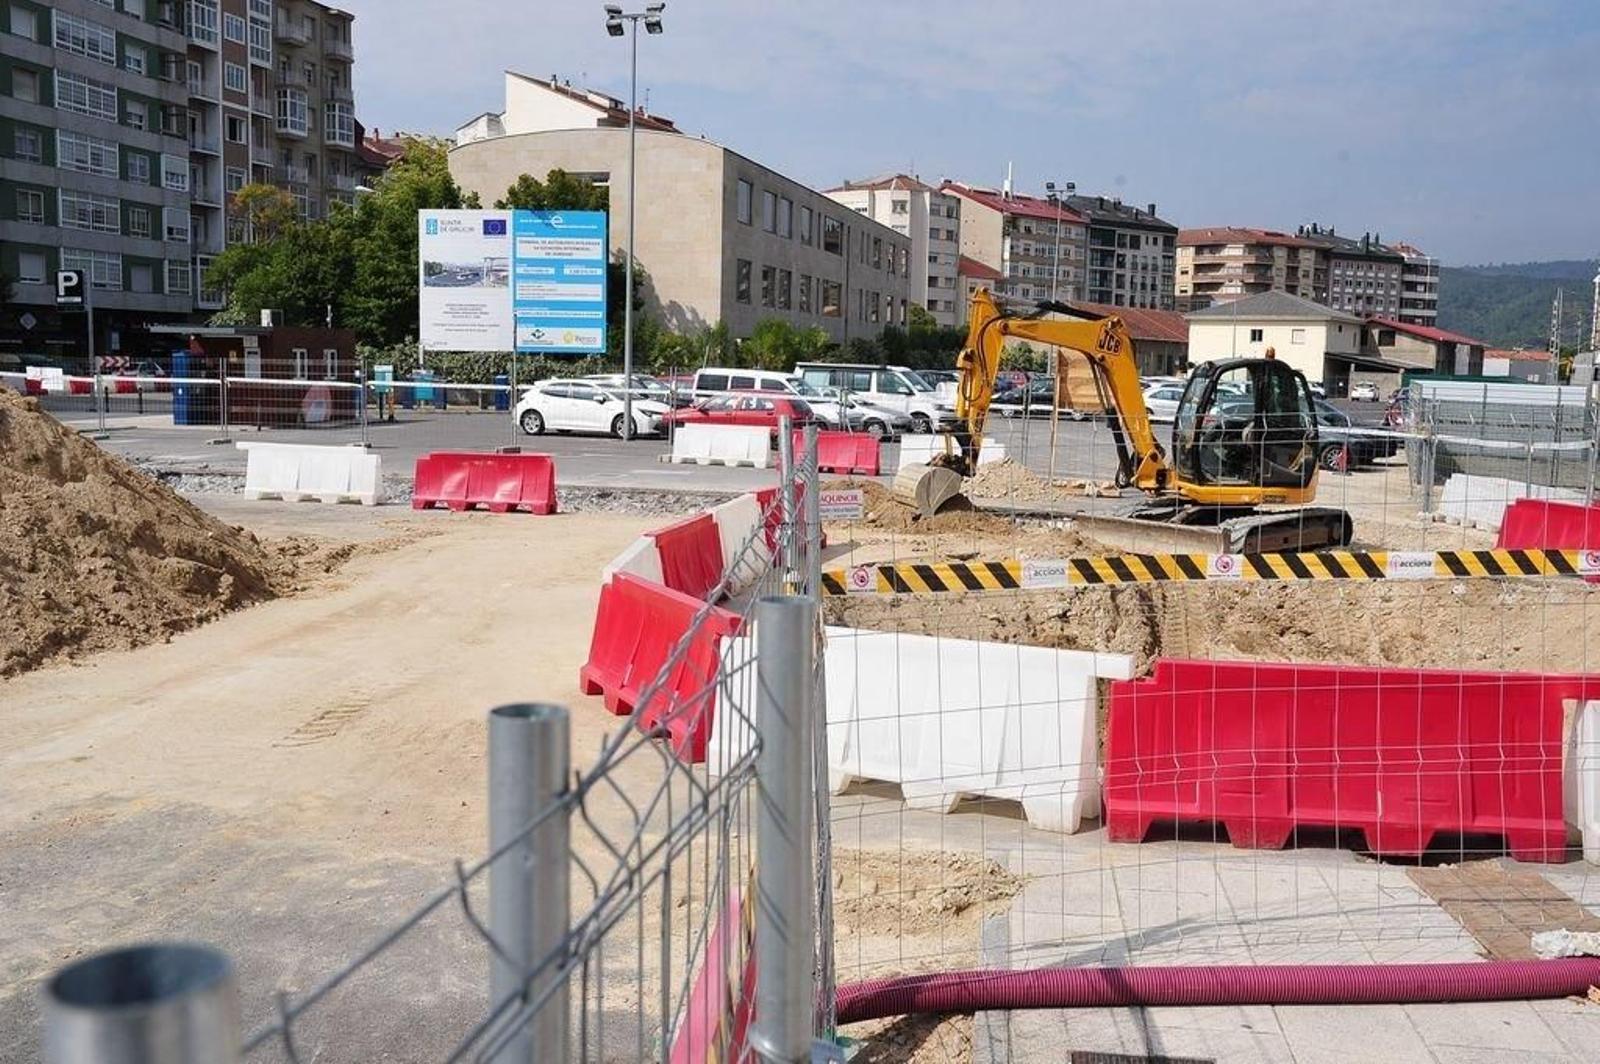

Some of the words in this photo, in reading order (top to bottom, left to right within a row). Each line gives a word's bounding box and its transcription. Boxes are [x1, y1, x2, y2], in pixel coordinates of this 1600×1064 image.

[58, 271, 79, 296] P
[1099, 329, 1121, 354] JCB
[1033, 566, 1066, 577] acciona
[1400, 559, 1432, 568] acciona
